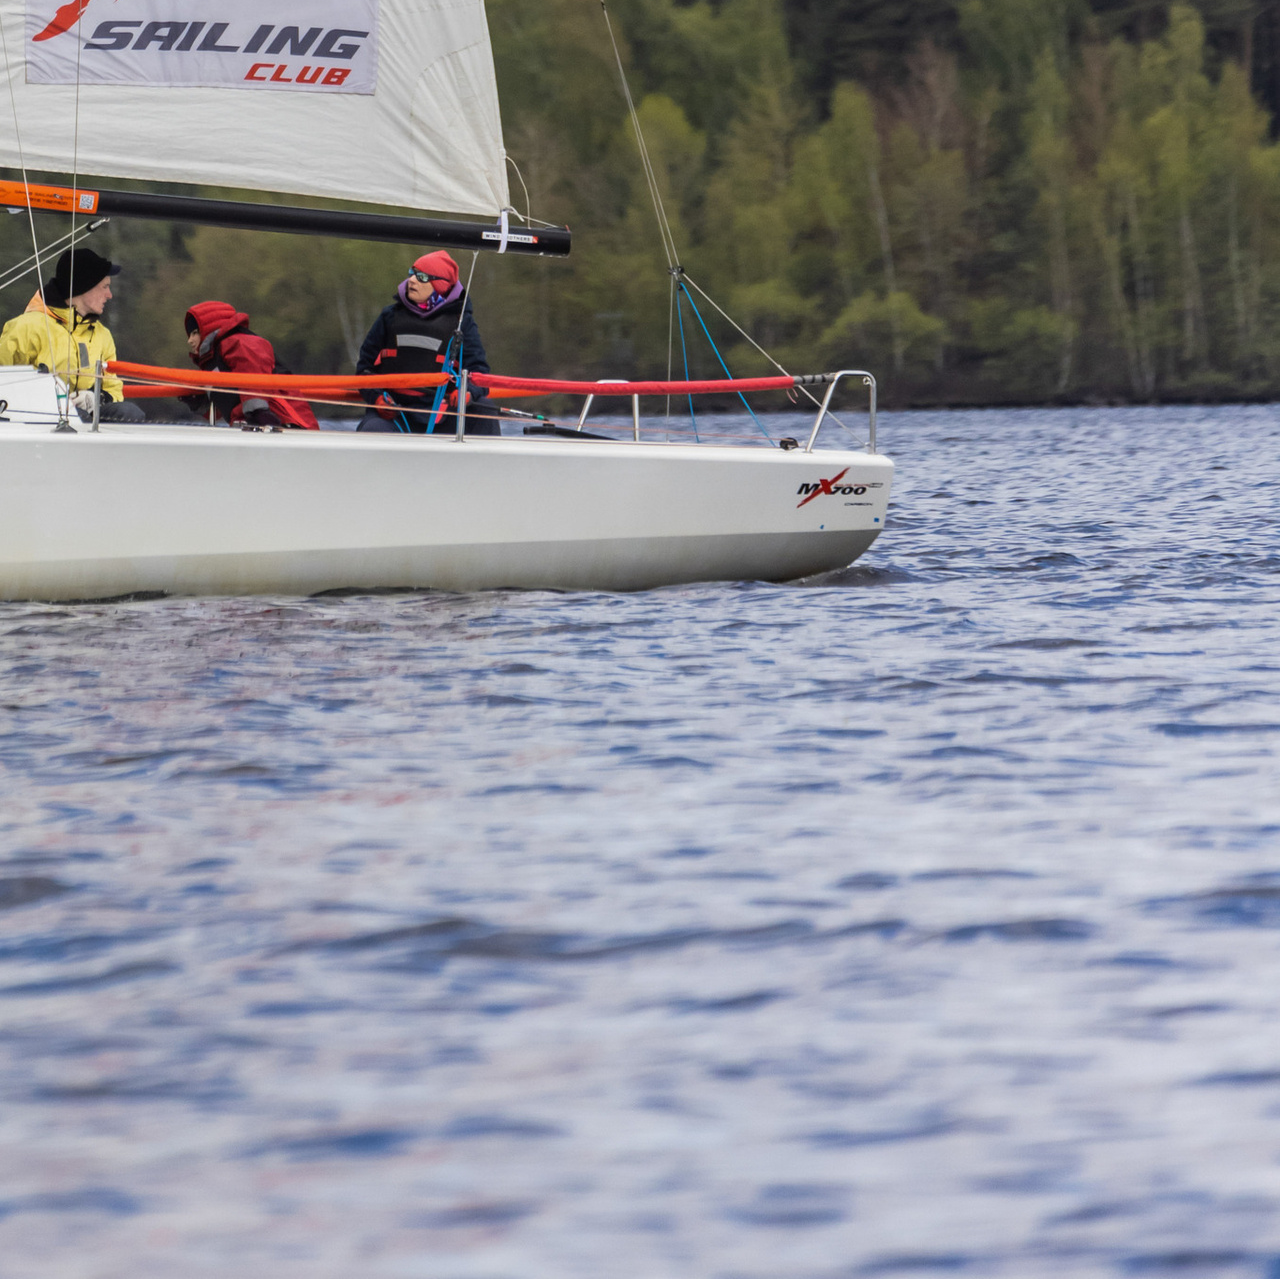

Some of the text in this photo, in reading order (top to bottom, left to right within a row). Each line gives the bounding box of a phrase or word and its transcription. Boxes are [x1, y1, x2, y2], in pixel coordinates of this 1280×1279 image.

[83, 20, 370, 60] SAILING
[244, 63, 352, 86] CLUB
[797, 467, 867, 508] MX700
